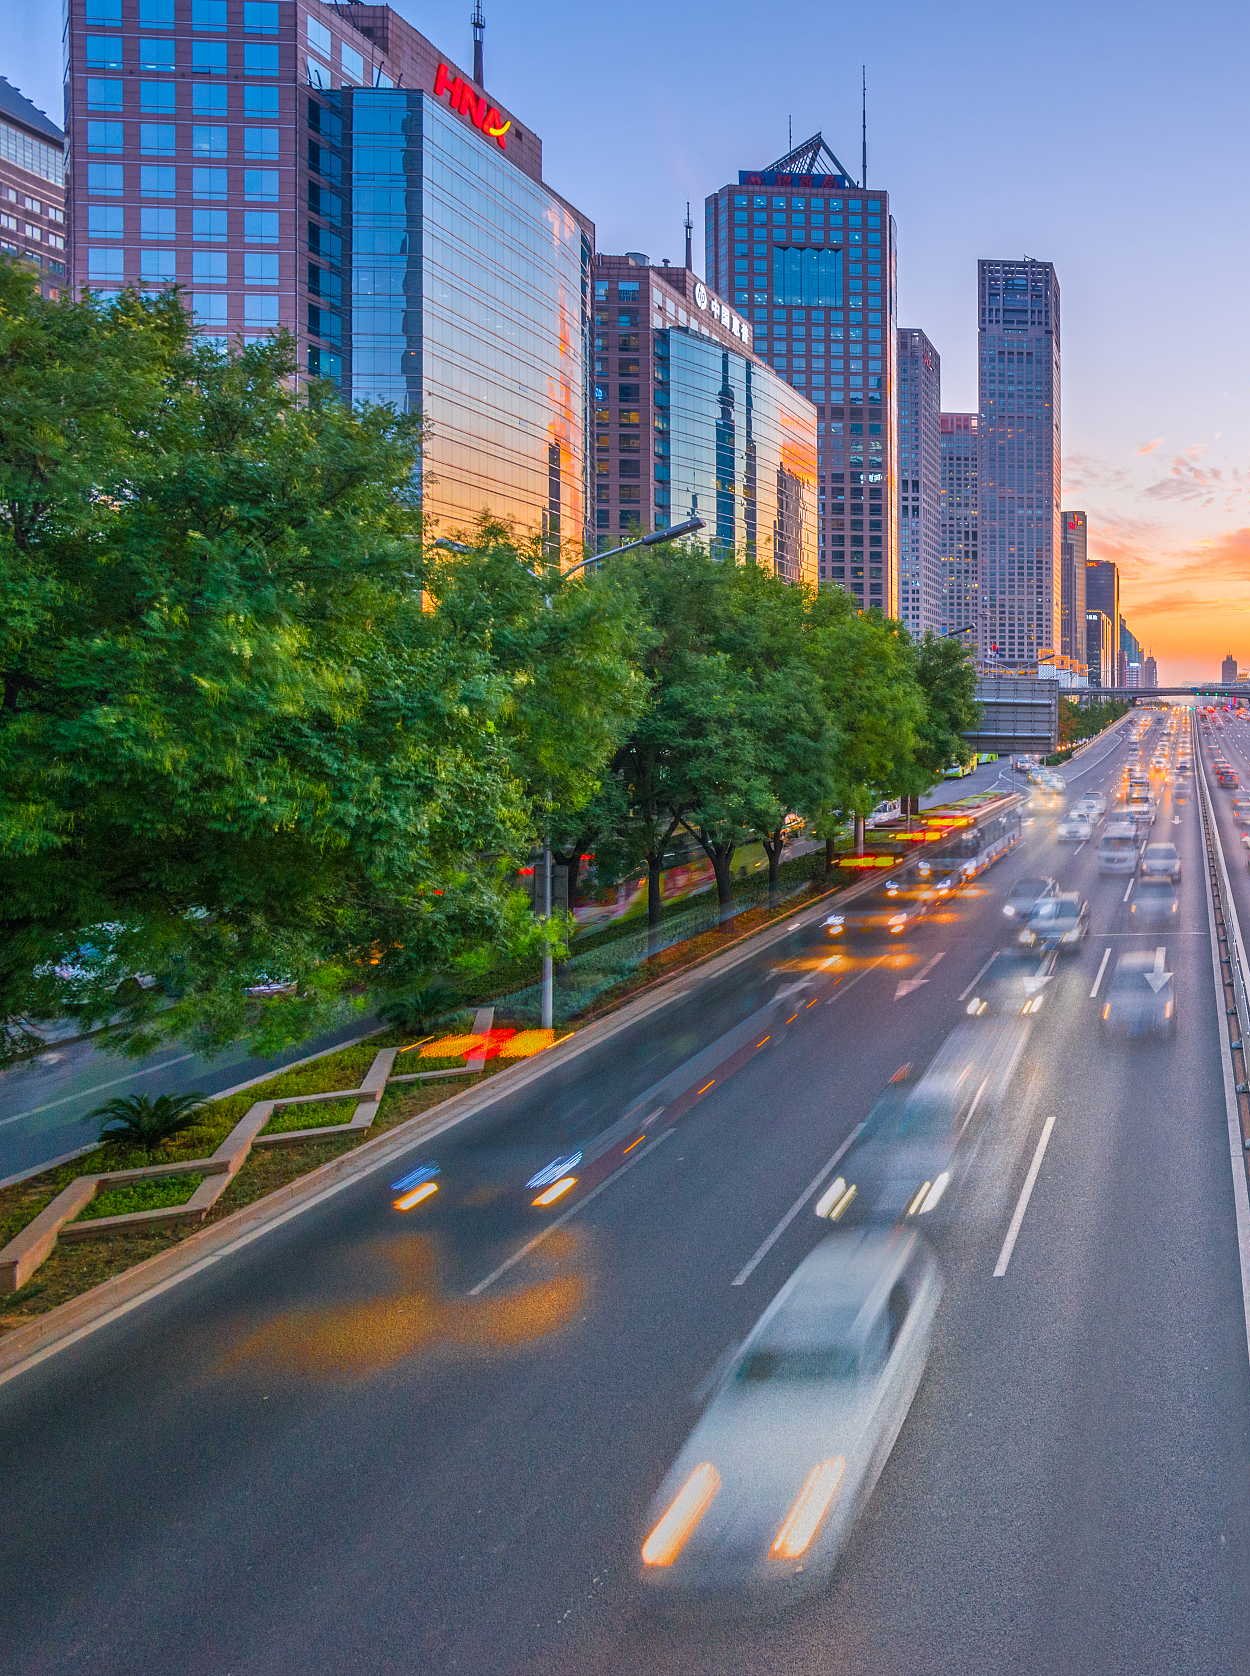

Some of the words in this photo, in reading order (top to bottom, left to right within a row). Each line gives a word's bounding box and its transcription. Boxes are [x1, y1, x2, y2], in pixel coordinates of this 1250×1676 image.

[435, 63, 511, 149] HNA
[775, 173, 838, 189] 招商局
[1068, 521, 1077, 530] SK
